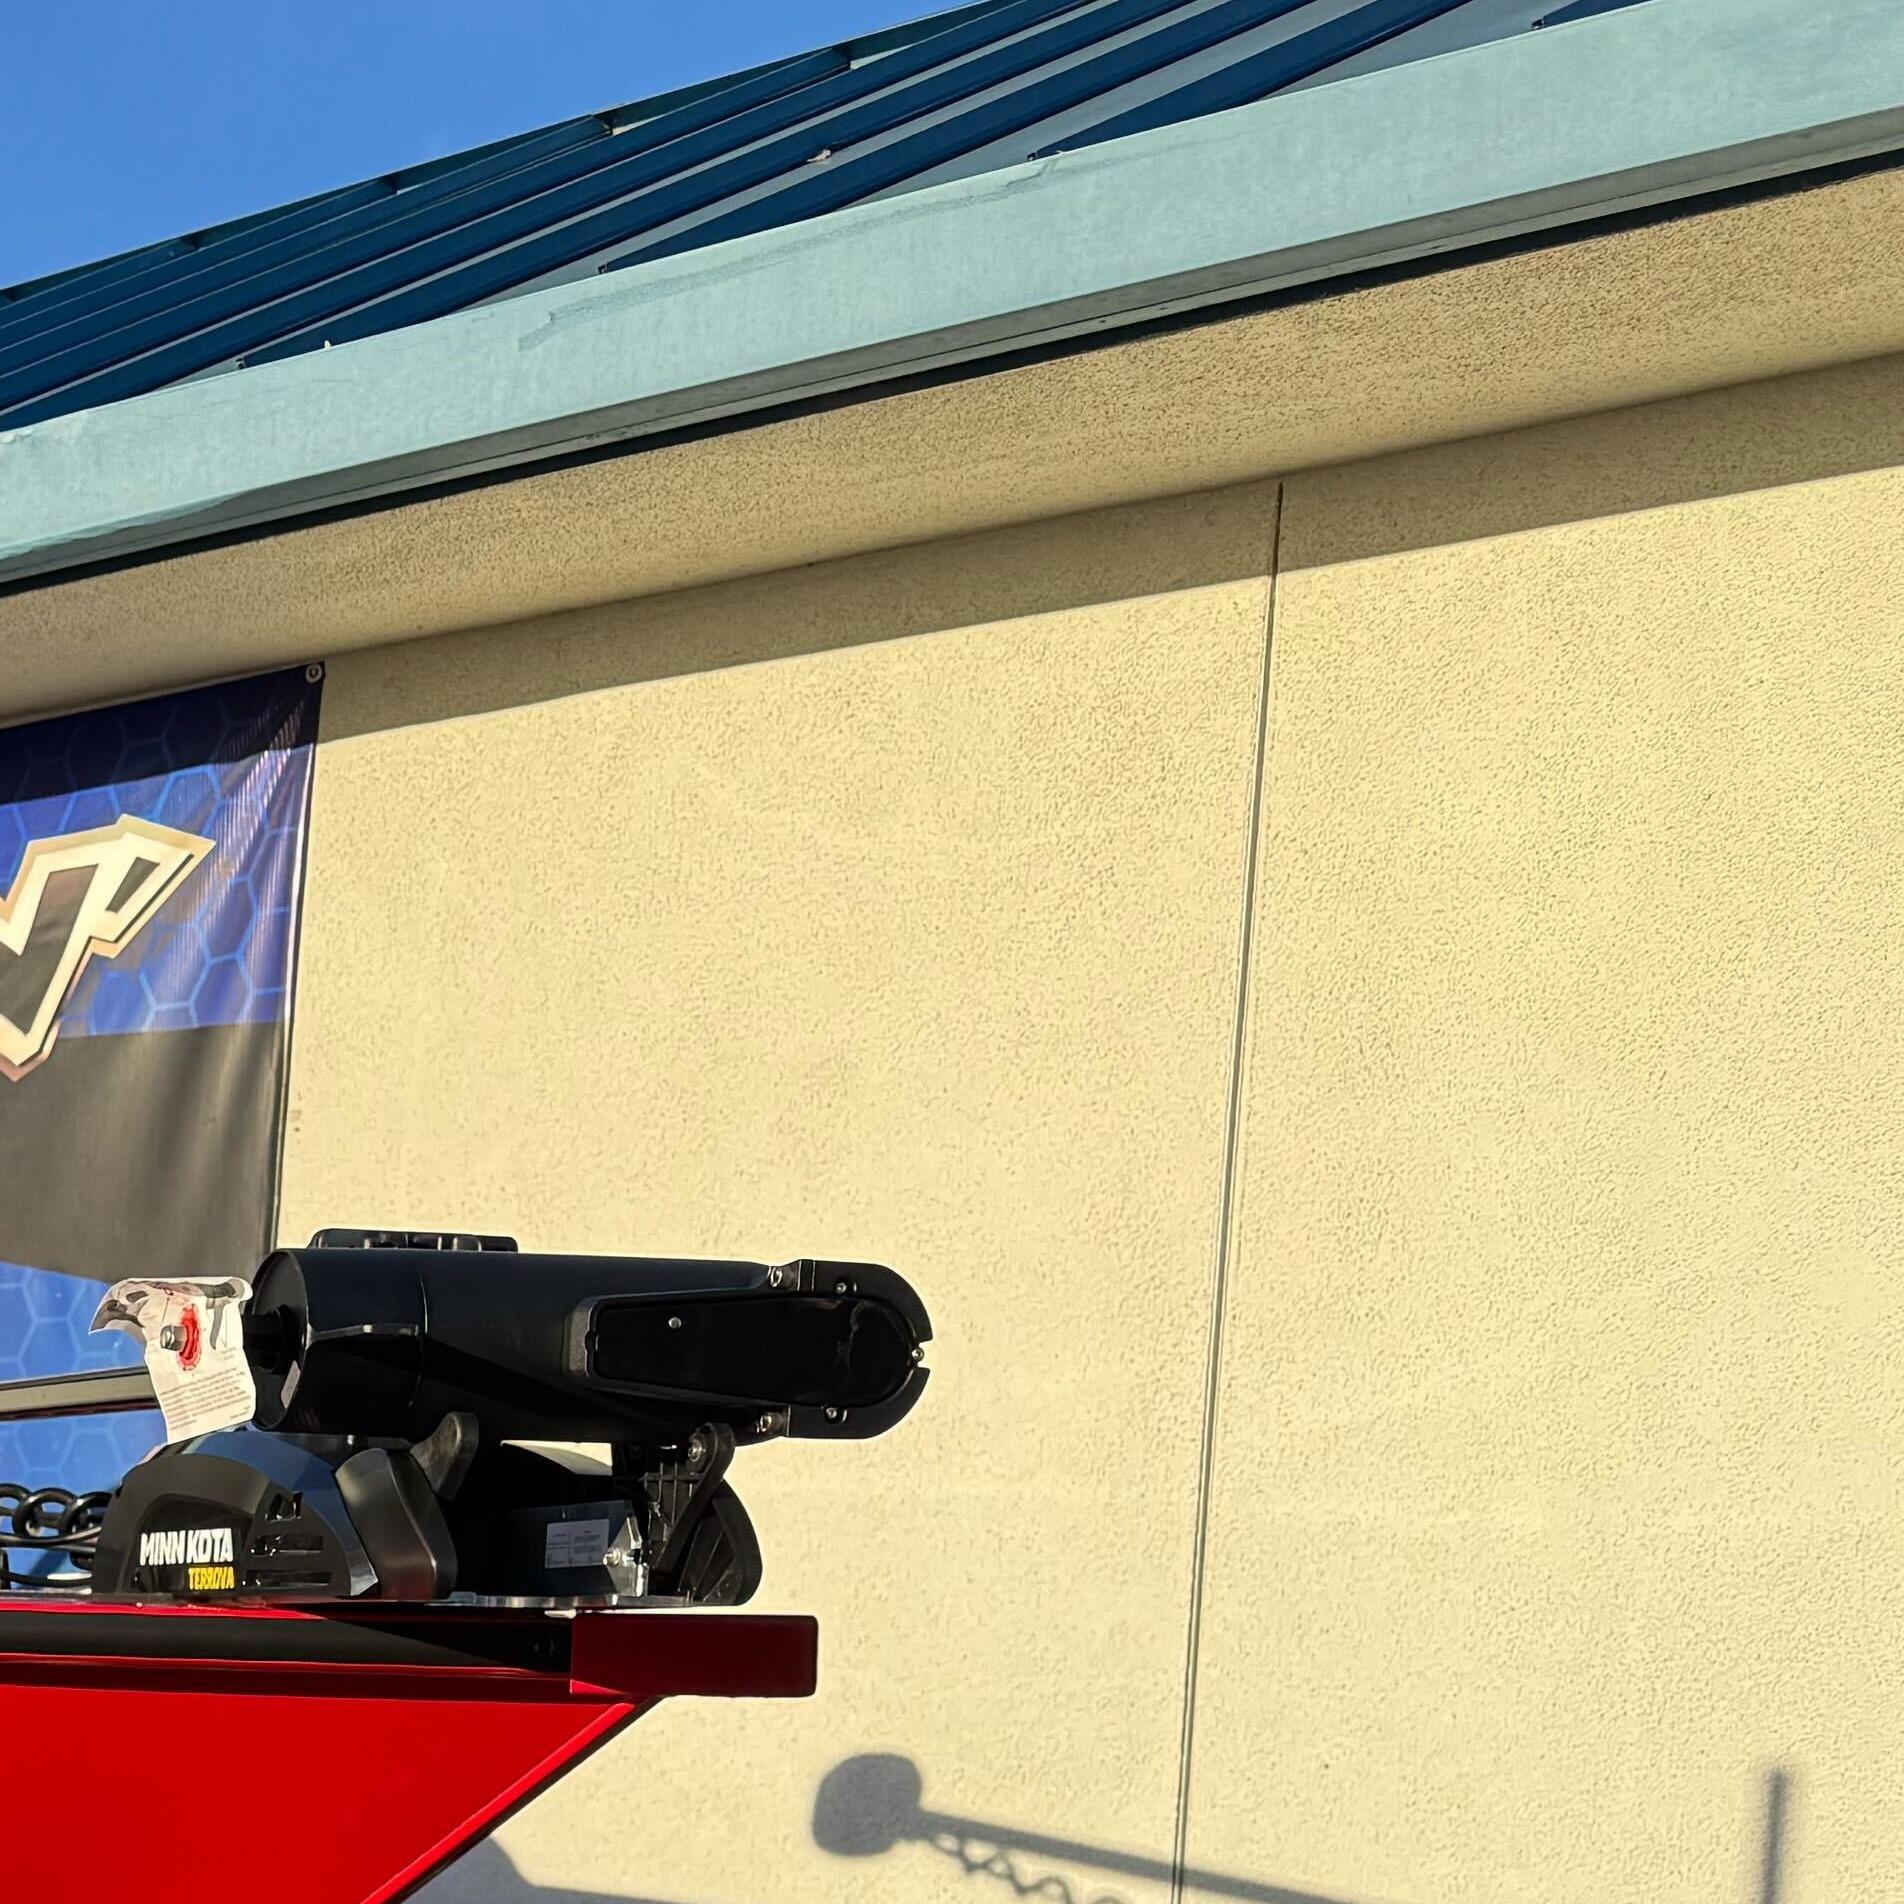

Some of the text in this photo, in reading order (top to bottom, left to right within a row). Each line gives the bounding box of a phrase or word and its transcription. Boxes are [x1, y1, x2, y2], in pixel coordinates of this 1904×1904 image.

[139, 1528, 234, 1566] MINN KOTA
[188, 1566, 235, 1590] TERROVA
